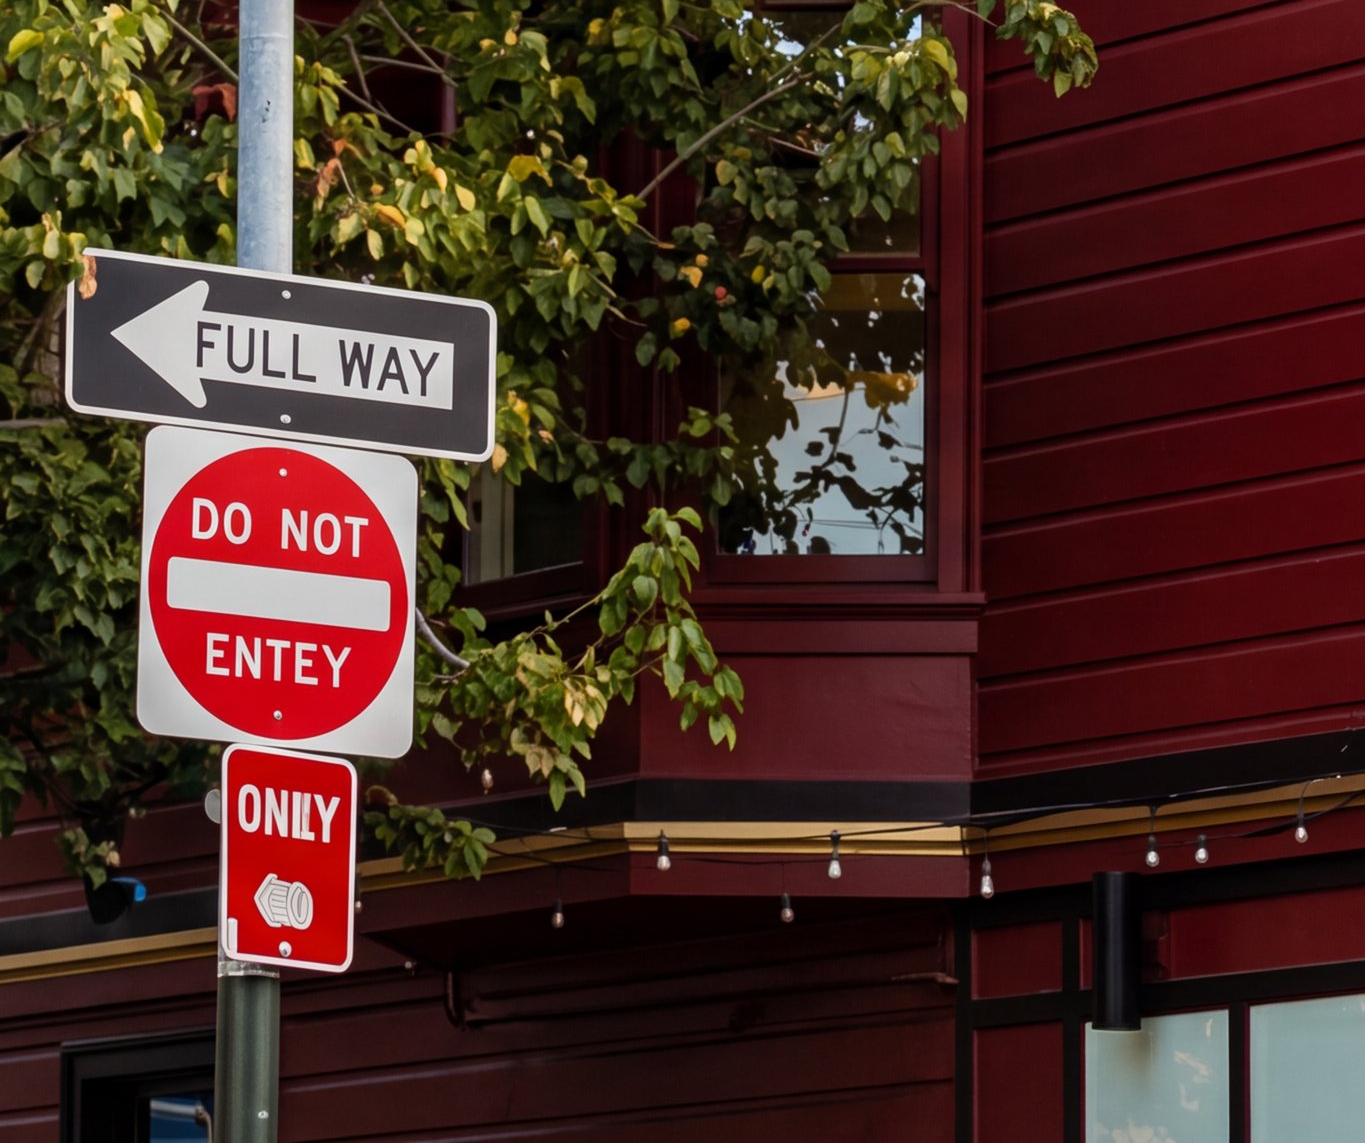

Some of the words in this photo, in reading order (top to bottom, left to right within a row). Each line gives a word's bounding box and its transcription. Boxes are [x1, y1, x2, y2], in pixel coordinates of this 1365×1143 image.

[196, 320, 317, 383] FULL
[338, 339, 441, 397] WAY
[191, 497, 252, 545] DO
[281, 508, 369, 558] NOT
[205, 632, 352, 688] ENTEY
